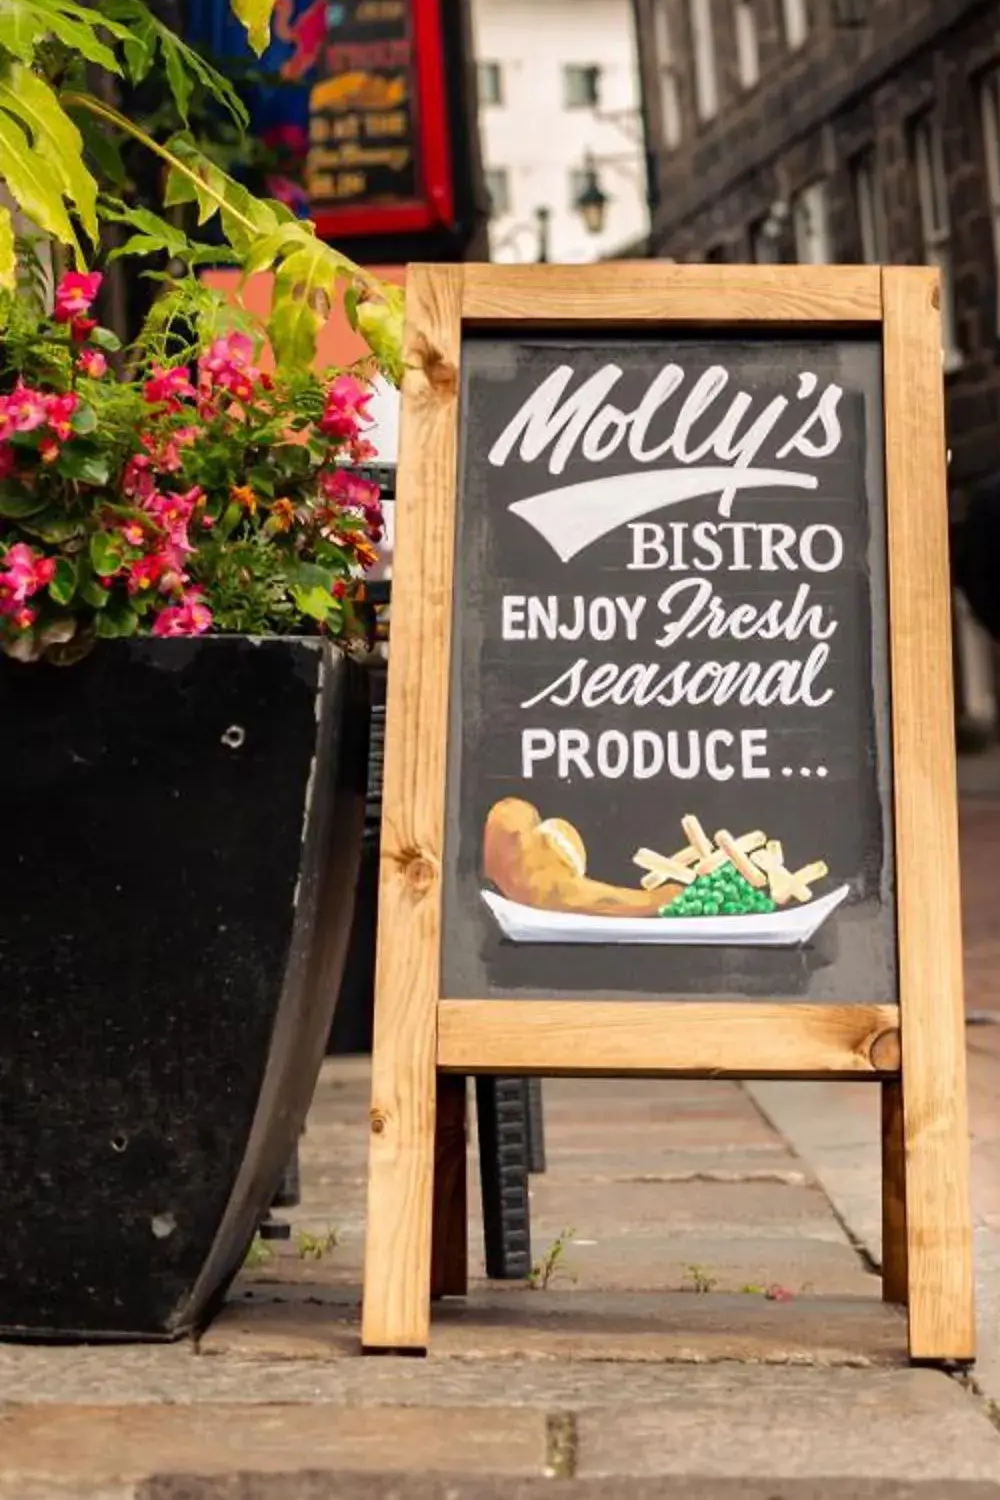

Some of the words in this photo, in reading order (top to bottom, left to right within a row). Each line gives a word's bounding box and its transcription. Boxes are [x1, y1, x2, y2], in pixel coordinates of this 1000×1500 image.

[487, 362, 844, 518] Molly's
[626, 520, 844, 573] BISTRO
[501, 594, 647, 641] ENJOY
[655, 576, 838, 648] Fresh
[519, 641, 834, 709] seasonal
[520, 727, 829, 780] PRODUCE...
